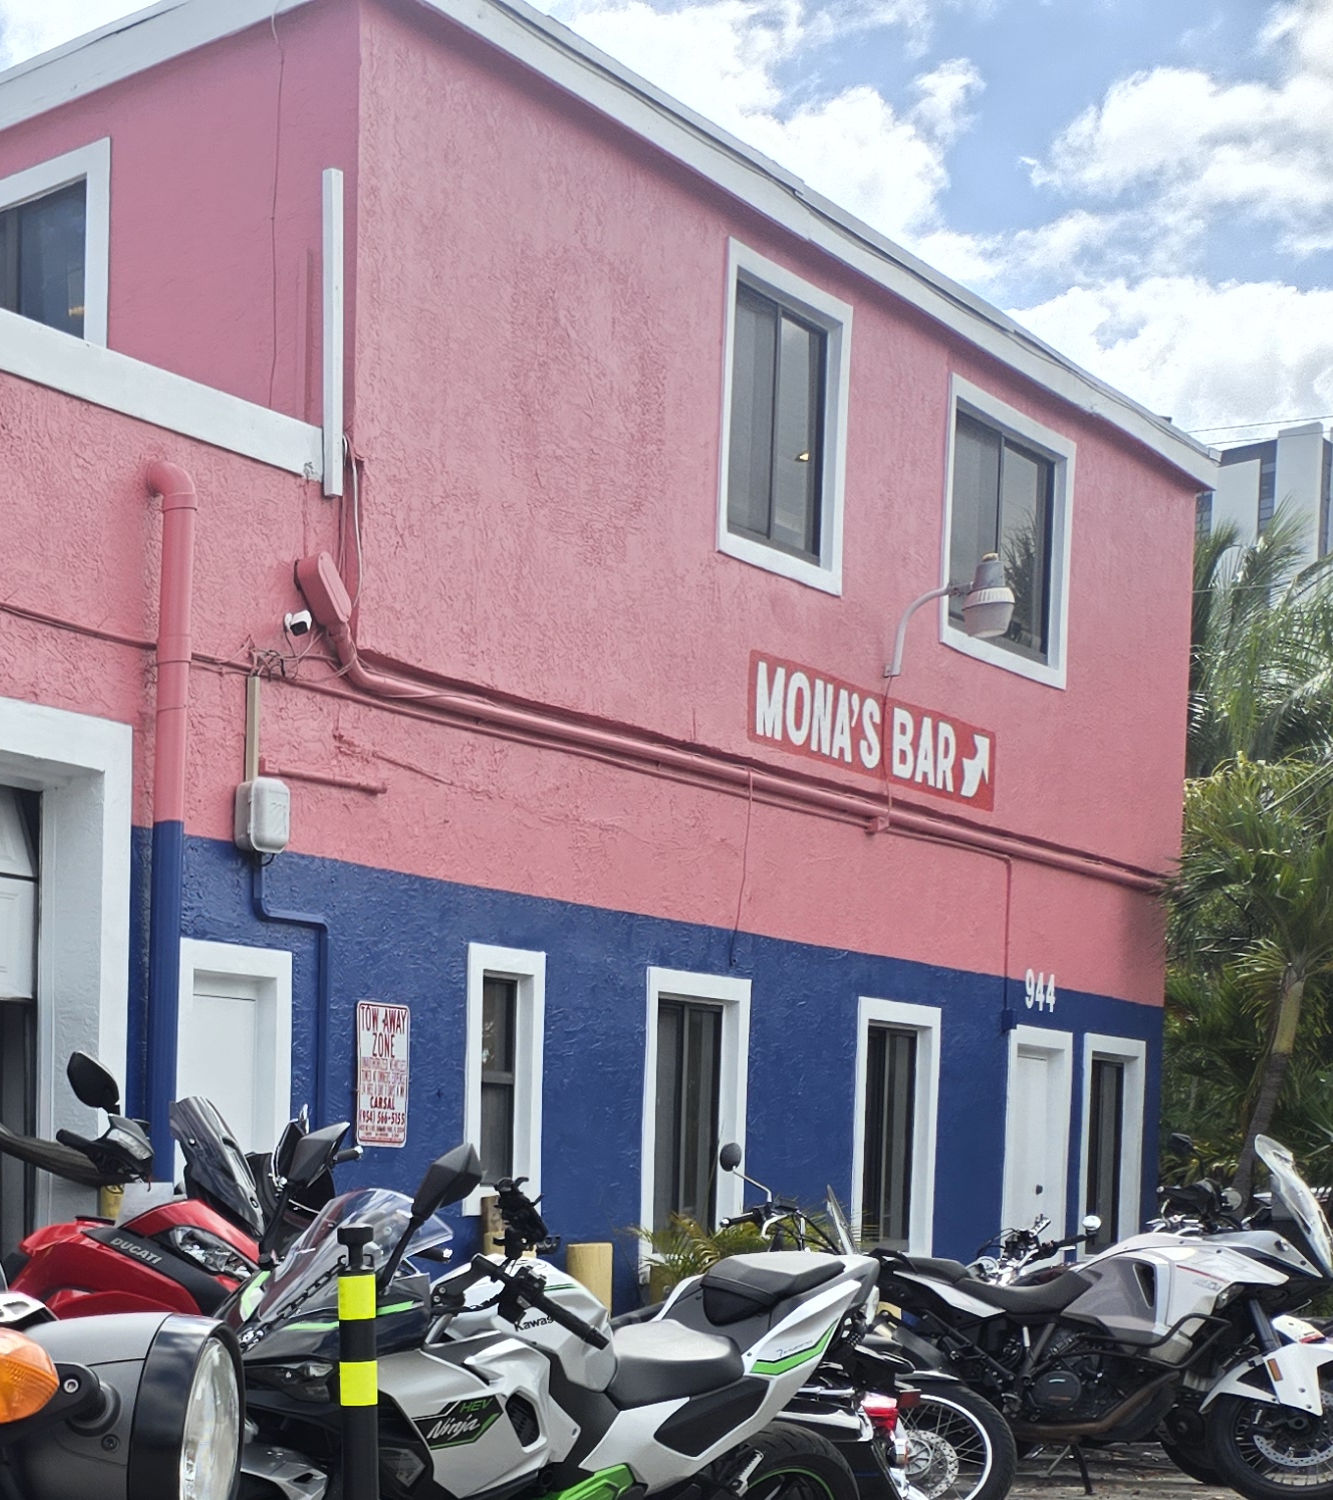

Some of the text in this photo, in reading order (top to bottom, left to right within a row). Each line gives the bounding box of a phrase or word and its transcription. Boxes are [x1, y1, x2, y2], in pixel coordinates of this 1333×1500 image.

[756, 660, 957, 793] MONA'S BAR
[1024, 968, 1056, 1013] 944
[361, 1005, 379, 1032] TOW
[372, 1033, 395, 1058] ZONE
[110, 1237, 163, 1264] DUCATI
[514, 1316, 555, 1332] Kawas
[459, 1398, 494, 1413] HEV
[426, 1414, 481, 1441] Ninja
